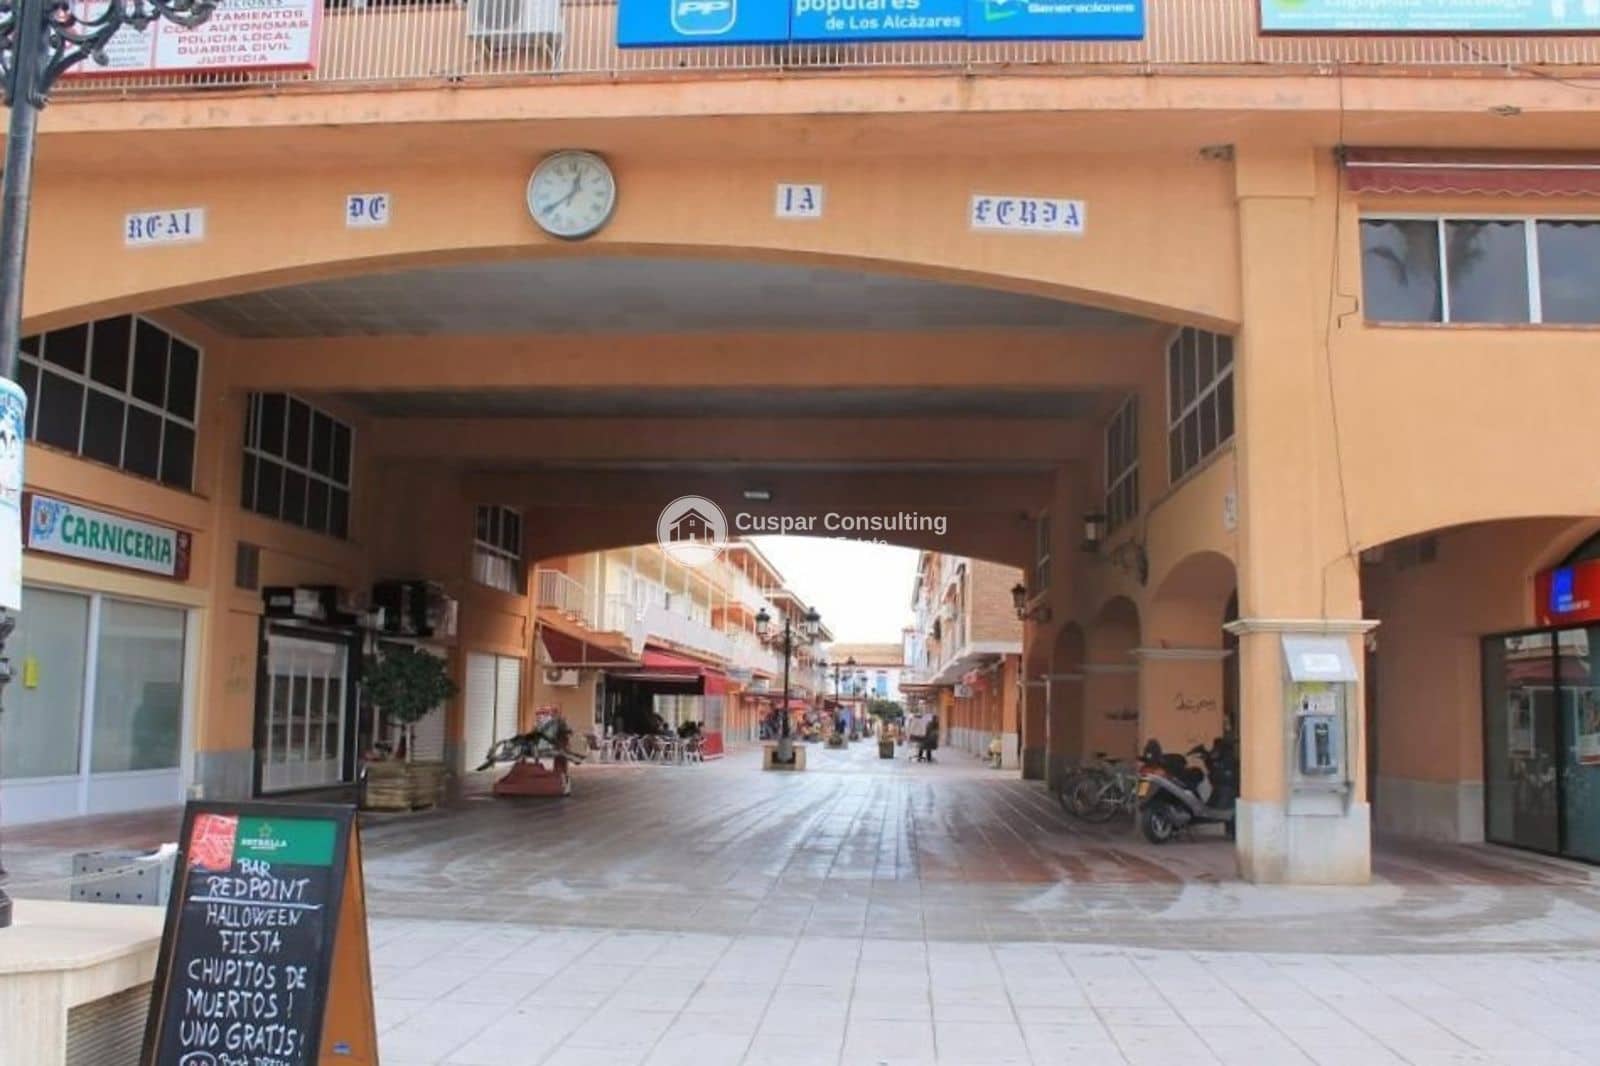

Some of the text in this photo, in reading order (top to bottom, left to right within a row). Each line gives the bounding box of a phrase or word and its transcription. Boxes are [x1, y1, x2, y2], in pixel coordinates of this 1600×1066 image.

[1028, 3, 1136, 14] Generaciones
[825, 16, 845, 30] de
[850, 15, 879, 30] Los
[177, 31, 292, 45] POLICIA LOCAL
[177, 41, 292, 55] GUARDIA CIVIL
[197, 53, 268, 65] JUSTICIA
[60, 513, 173, 564] CARNICERIA
[237, 857, 272, 877] BAR
[206, 903, 303, 928] HALLOWEEN
[219, 929, 282, 954] FIESTA
[187, 958, 308, 990] CHUPITOS DE
[180, 1020, 221, 1047] UNO
